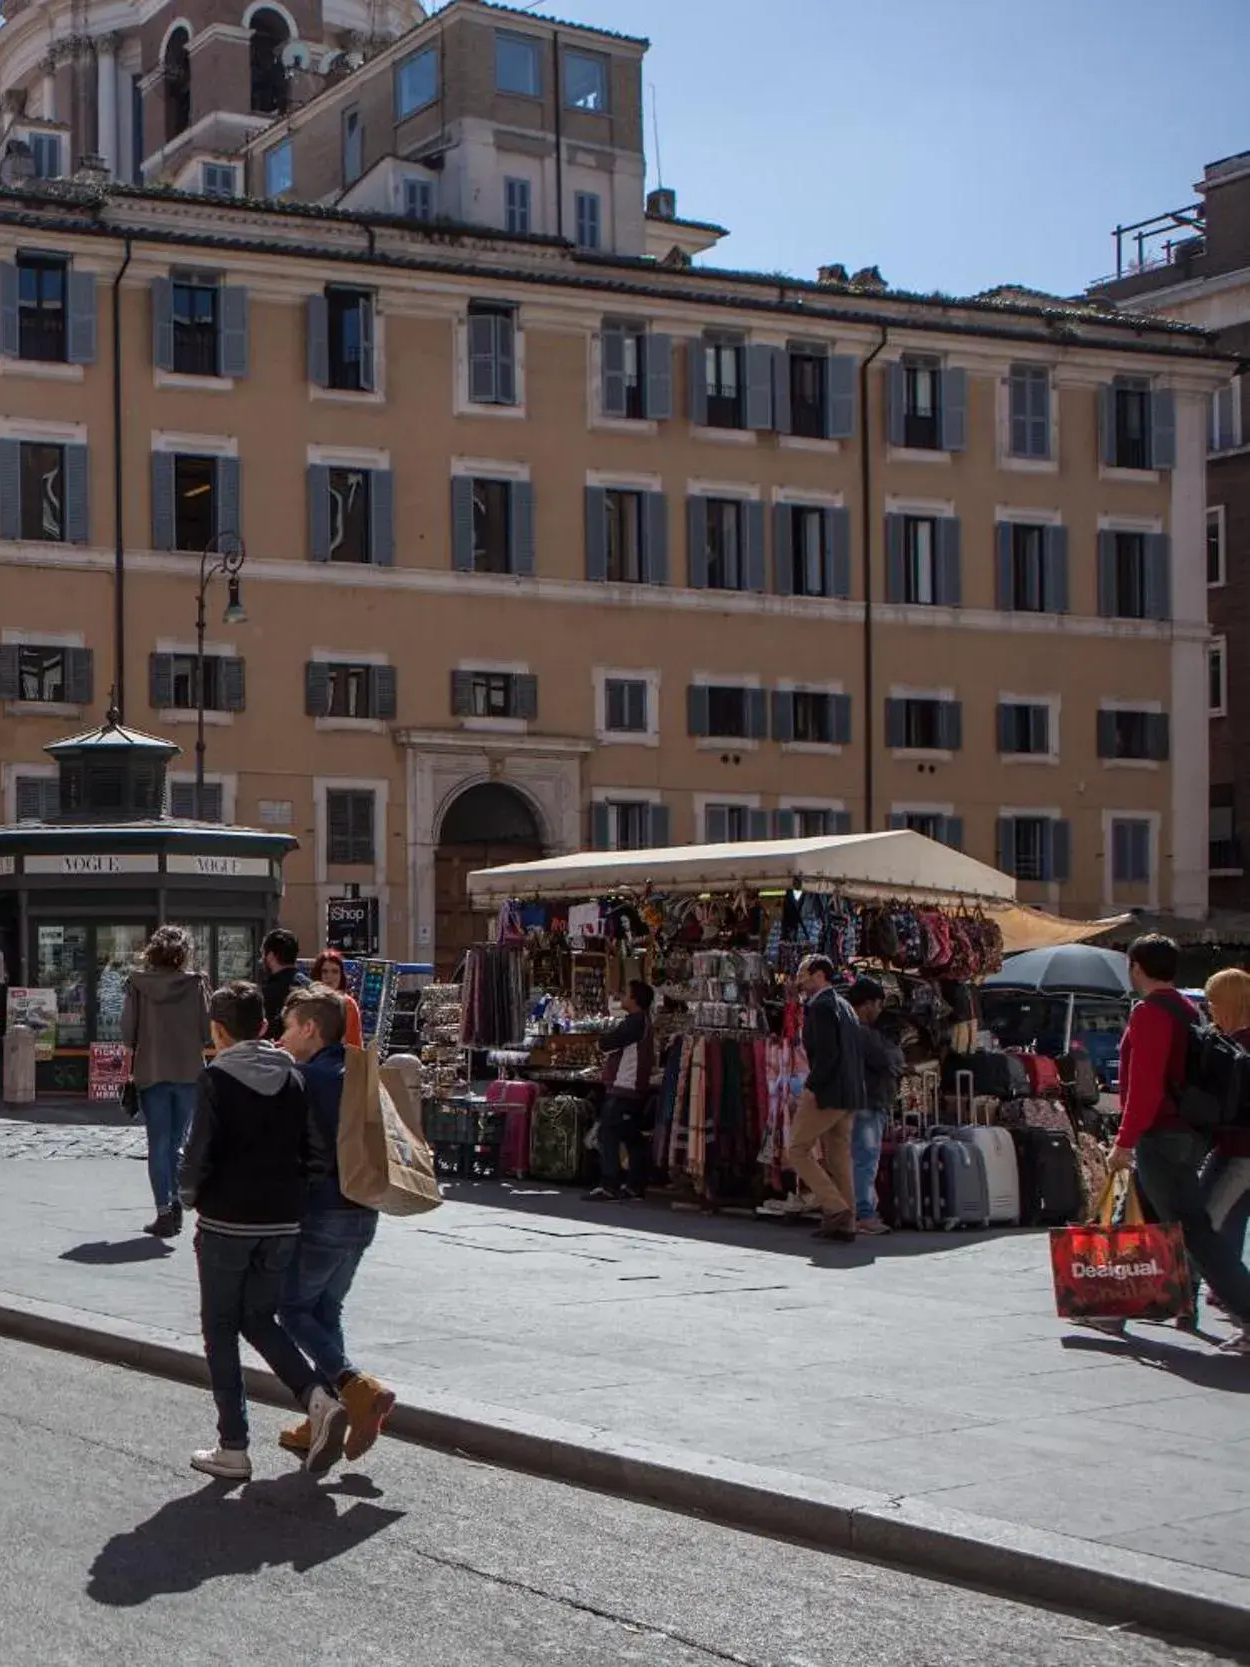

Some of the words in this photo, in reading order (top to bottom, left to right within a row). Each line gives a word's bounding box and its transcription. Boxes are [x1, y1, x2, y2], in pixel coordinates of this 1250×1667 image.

[64, 856, 119, 872] VOGUE
[195, 857, 240, 873] VOGUE
[331, 906, 364, 923] iShop
